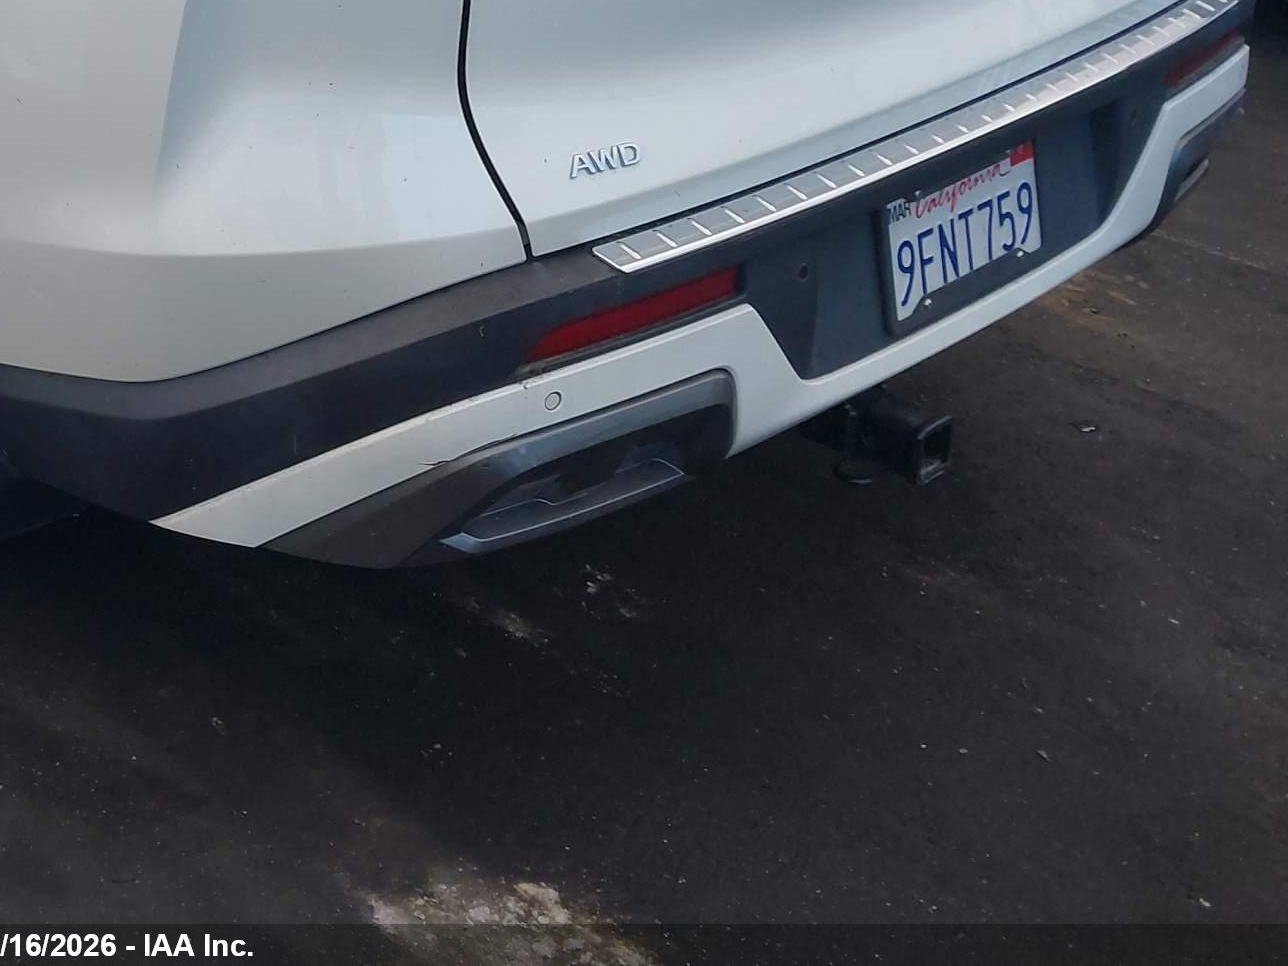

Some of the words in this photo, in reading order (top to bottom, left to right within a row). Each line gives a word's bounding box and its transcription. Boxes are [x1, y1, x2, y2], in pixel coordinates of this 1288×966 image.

[569, 141, 642, 180] AWD
[915, 162, 1010, 219] California
[896, 181, 1034, 307] 9FNT759
